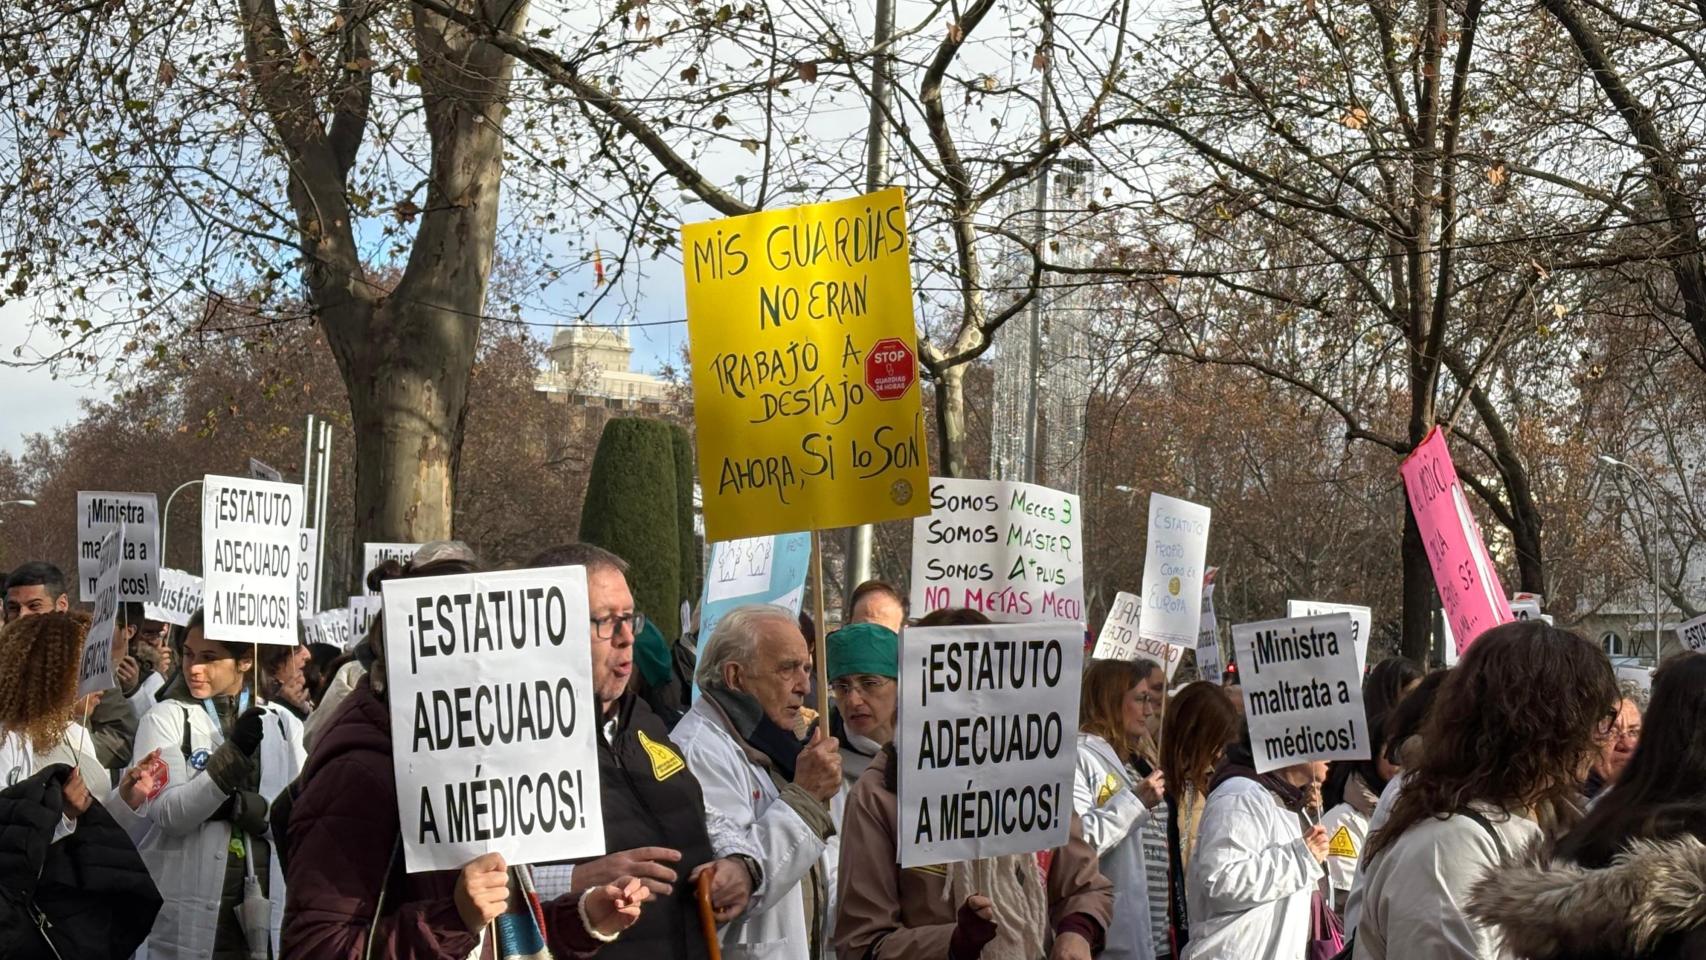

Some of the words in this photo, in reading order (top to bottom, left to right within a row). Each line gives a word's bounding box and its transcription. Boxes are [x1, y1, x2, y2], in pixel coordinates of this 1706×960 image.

[695, 230, 749, 283] MIS
[767, 206, 905, 271] GUARDIAS
[760, 284, 800, 330] NO
[808, 275, 868, 324] ERAN
[710, 339, 819, 399] TRABAJO
[842, 334, 862, 368] A
[874, 350, 905, 364] STOP
[750, 374, 864, 425] DESTAJO
[718, 456, 805, 505] AHORA,
[801, 432, 835, 480] SI
[87, 498, 145, 529] ¡Ministra
[215, 487, 292, 529] ¡ESTATUTO
[930, 484, 998, 513] SOMOS
[1060, 499, 1072, 524] 3
[139, 543, 147, 560] a
[926, 519, 998, 545] SOMOS
[213, 538, 291, 578] ADECUADO
[925, 558, 994, 581] SOMOS
[1458, 559, 1474, 591] SE
[212, 590, 222, 625] A
[226, 583, 290, 630] MÉDICOS!
[924, 586, 950, 612] NO
[408, 585, 567, 675] ¡ESTATUTO
[1250, 626, 1340, 674] ¡Ministra
[921, 639, 1063, 706] ¡ESTATUTO
[412, 677, 577, 752] ADECUADO
[1249, 678, 1332, 716] maltrata
[1337, 680, 1350, 704] a
[917, 711, 1063, 770] ADECUADO
[1265, 720, 1357, 760] médicos!
[419, 786, 441, 844] A
[445, 764, 586, 844] MÉDICOS!
[915, 796, 933, 844] A
[939, 780, 1061, 841] MÉDICOS!
